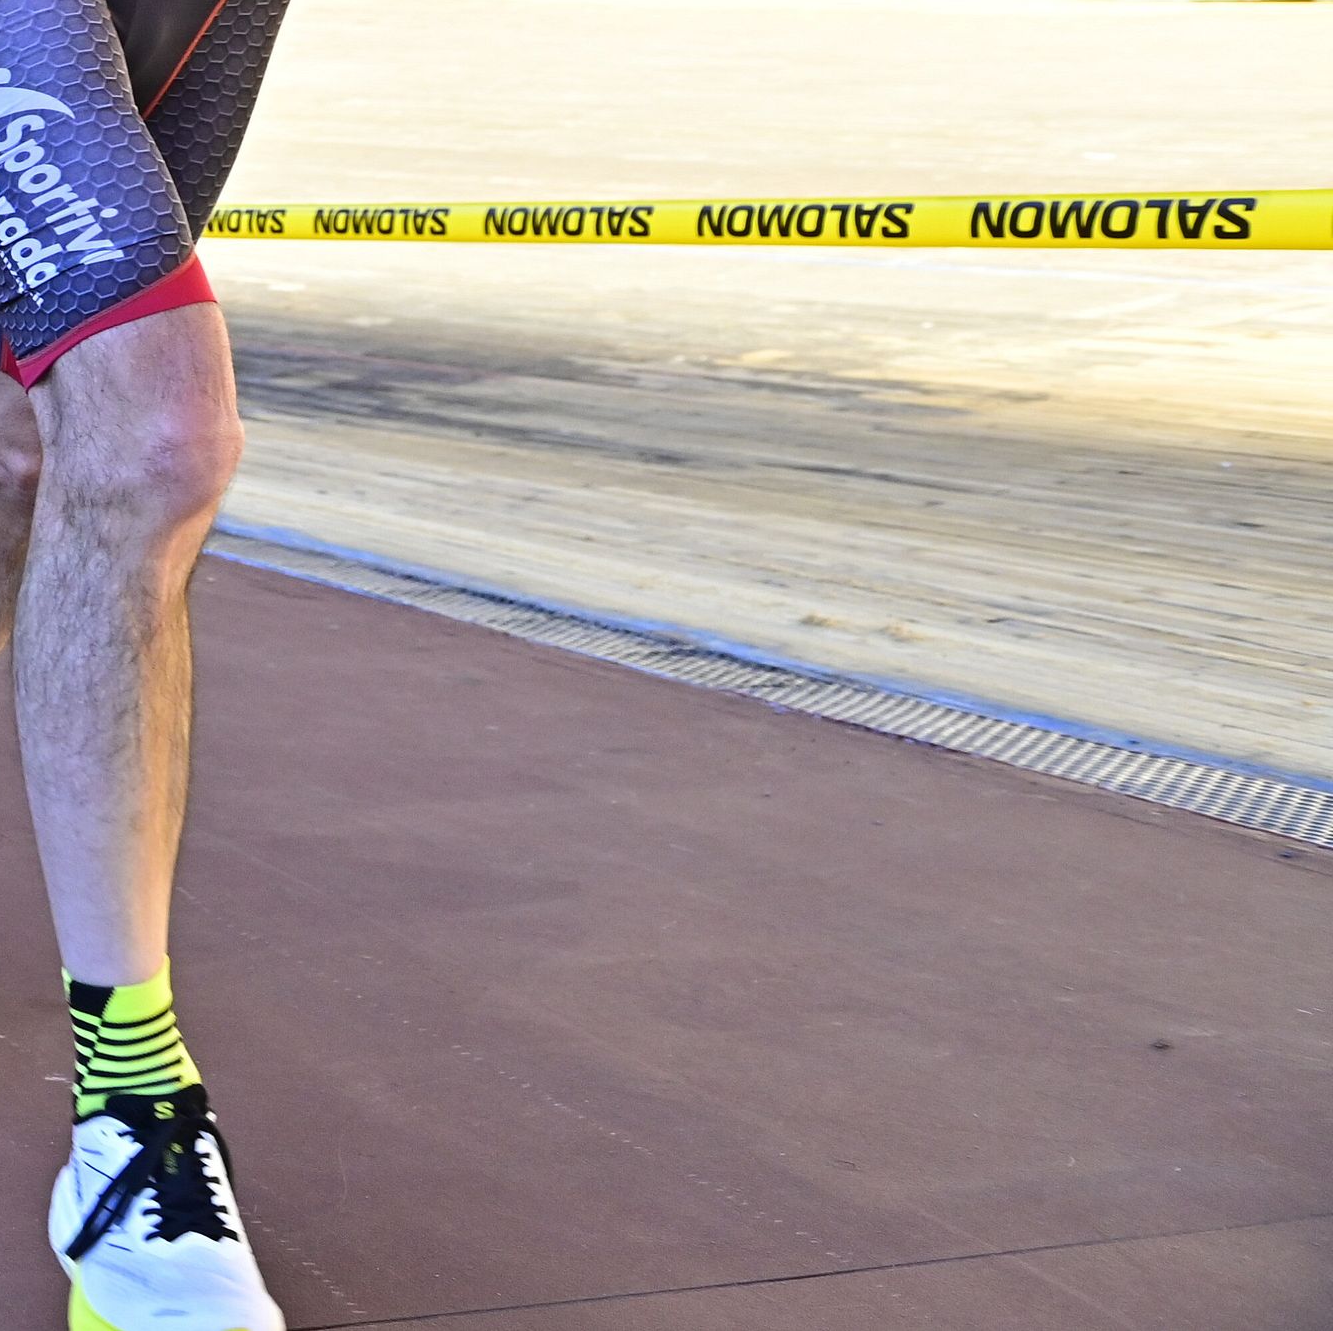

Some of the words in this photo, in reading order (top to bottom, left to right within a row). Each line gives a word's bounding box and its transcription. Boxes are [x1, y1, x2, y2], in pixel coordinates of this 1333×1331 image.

[207, 209, 286, 233] SALOM
[314, 207, 449, 236] SALOMON
[484, 205, 654, 237] SALOMON
[697, 203, 914, 239] SALOMON
[970, 197, 1257, 240] SALOMON
